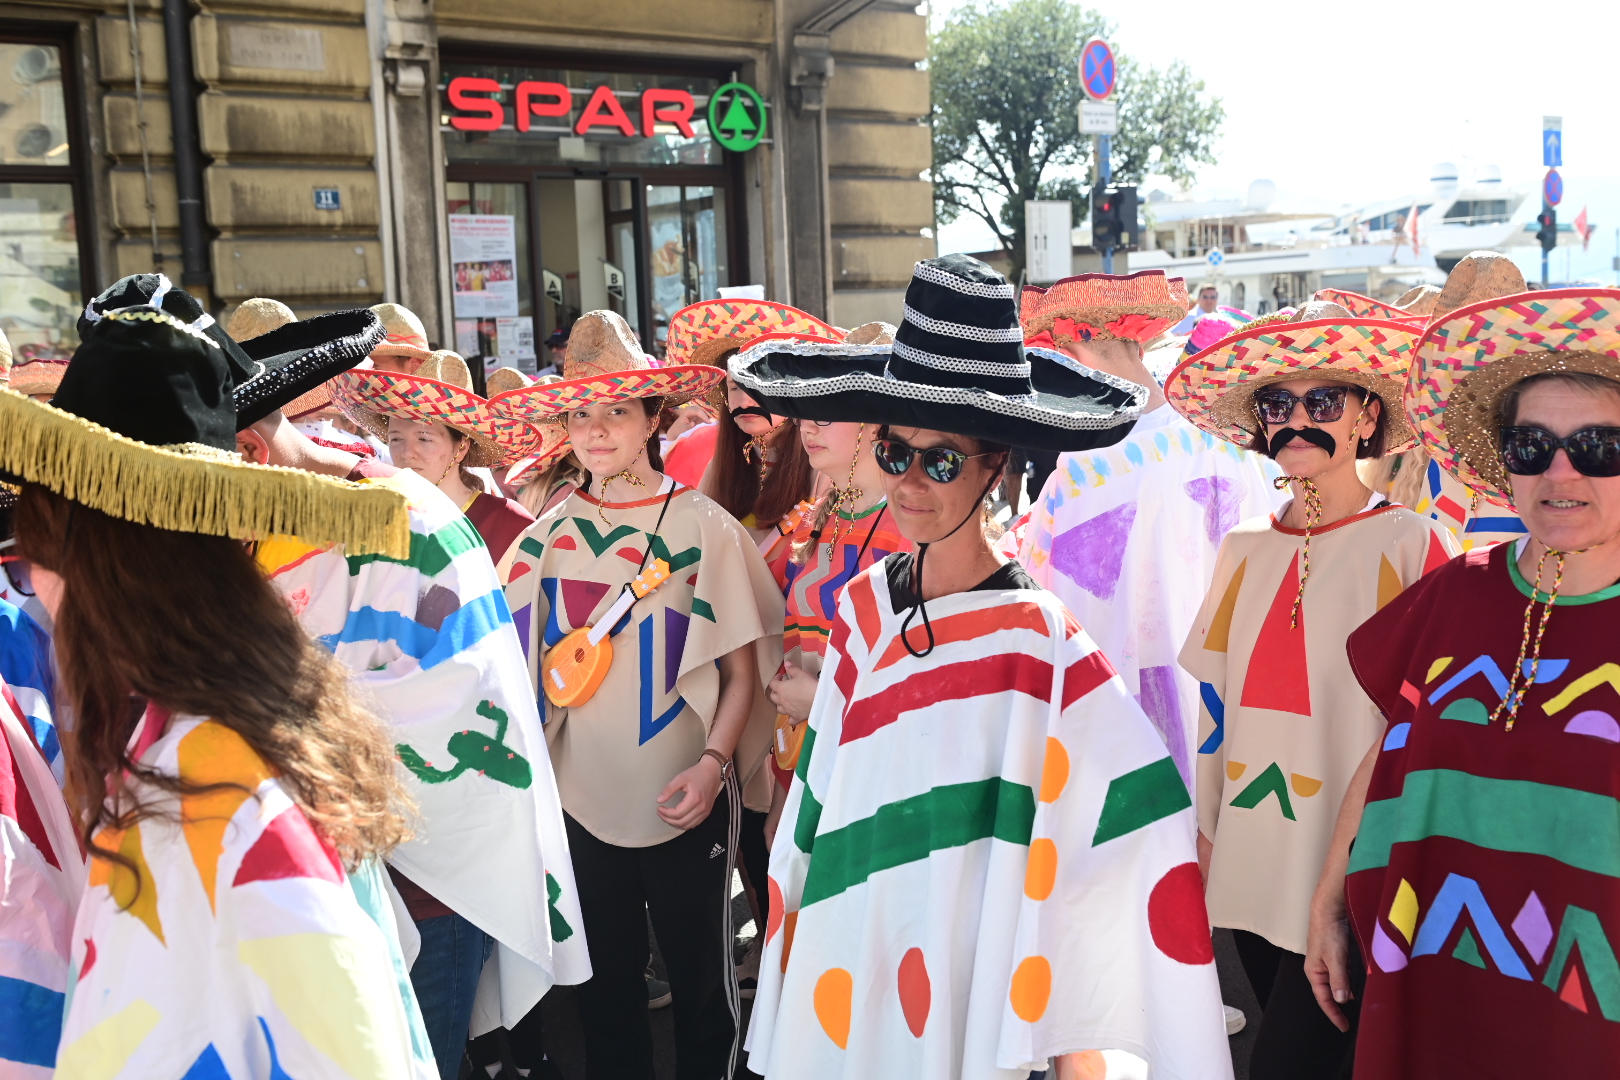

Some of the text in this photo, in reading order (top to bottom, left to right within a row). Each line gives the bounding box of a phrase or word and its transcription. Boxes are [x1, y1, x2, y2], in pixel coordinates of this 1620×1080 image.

[447, 76, 696, 139] SPAR
[319, 191, 334, 204] 11
[549, 280, 557, 289] A
[611, 273, 618, 284] B
